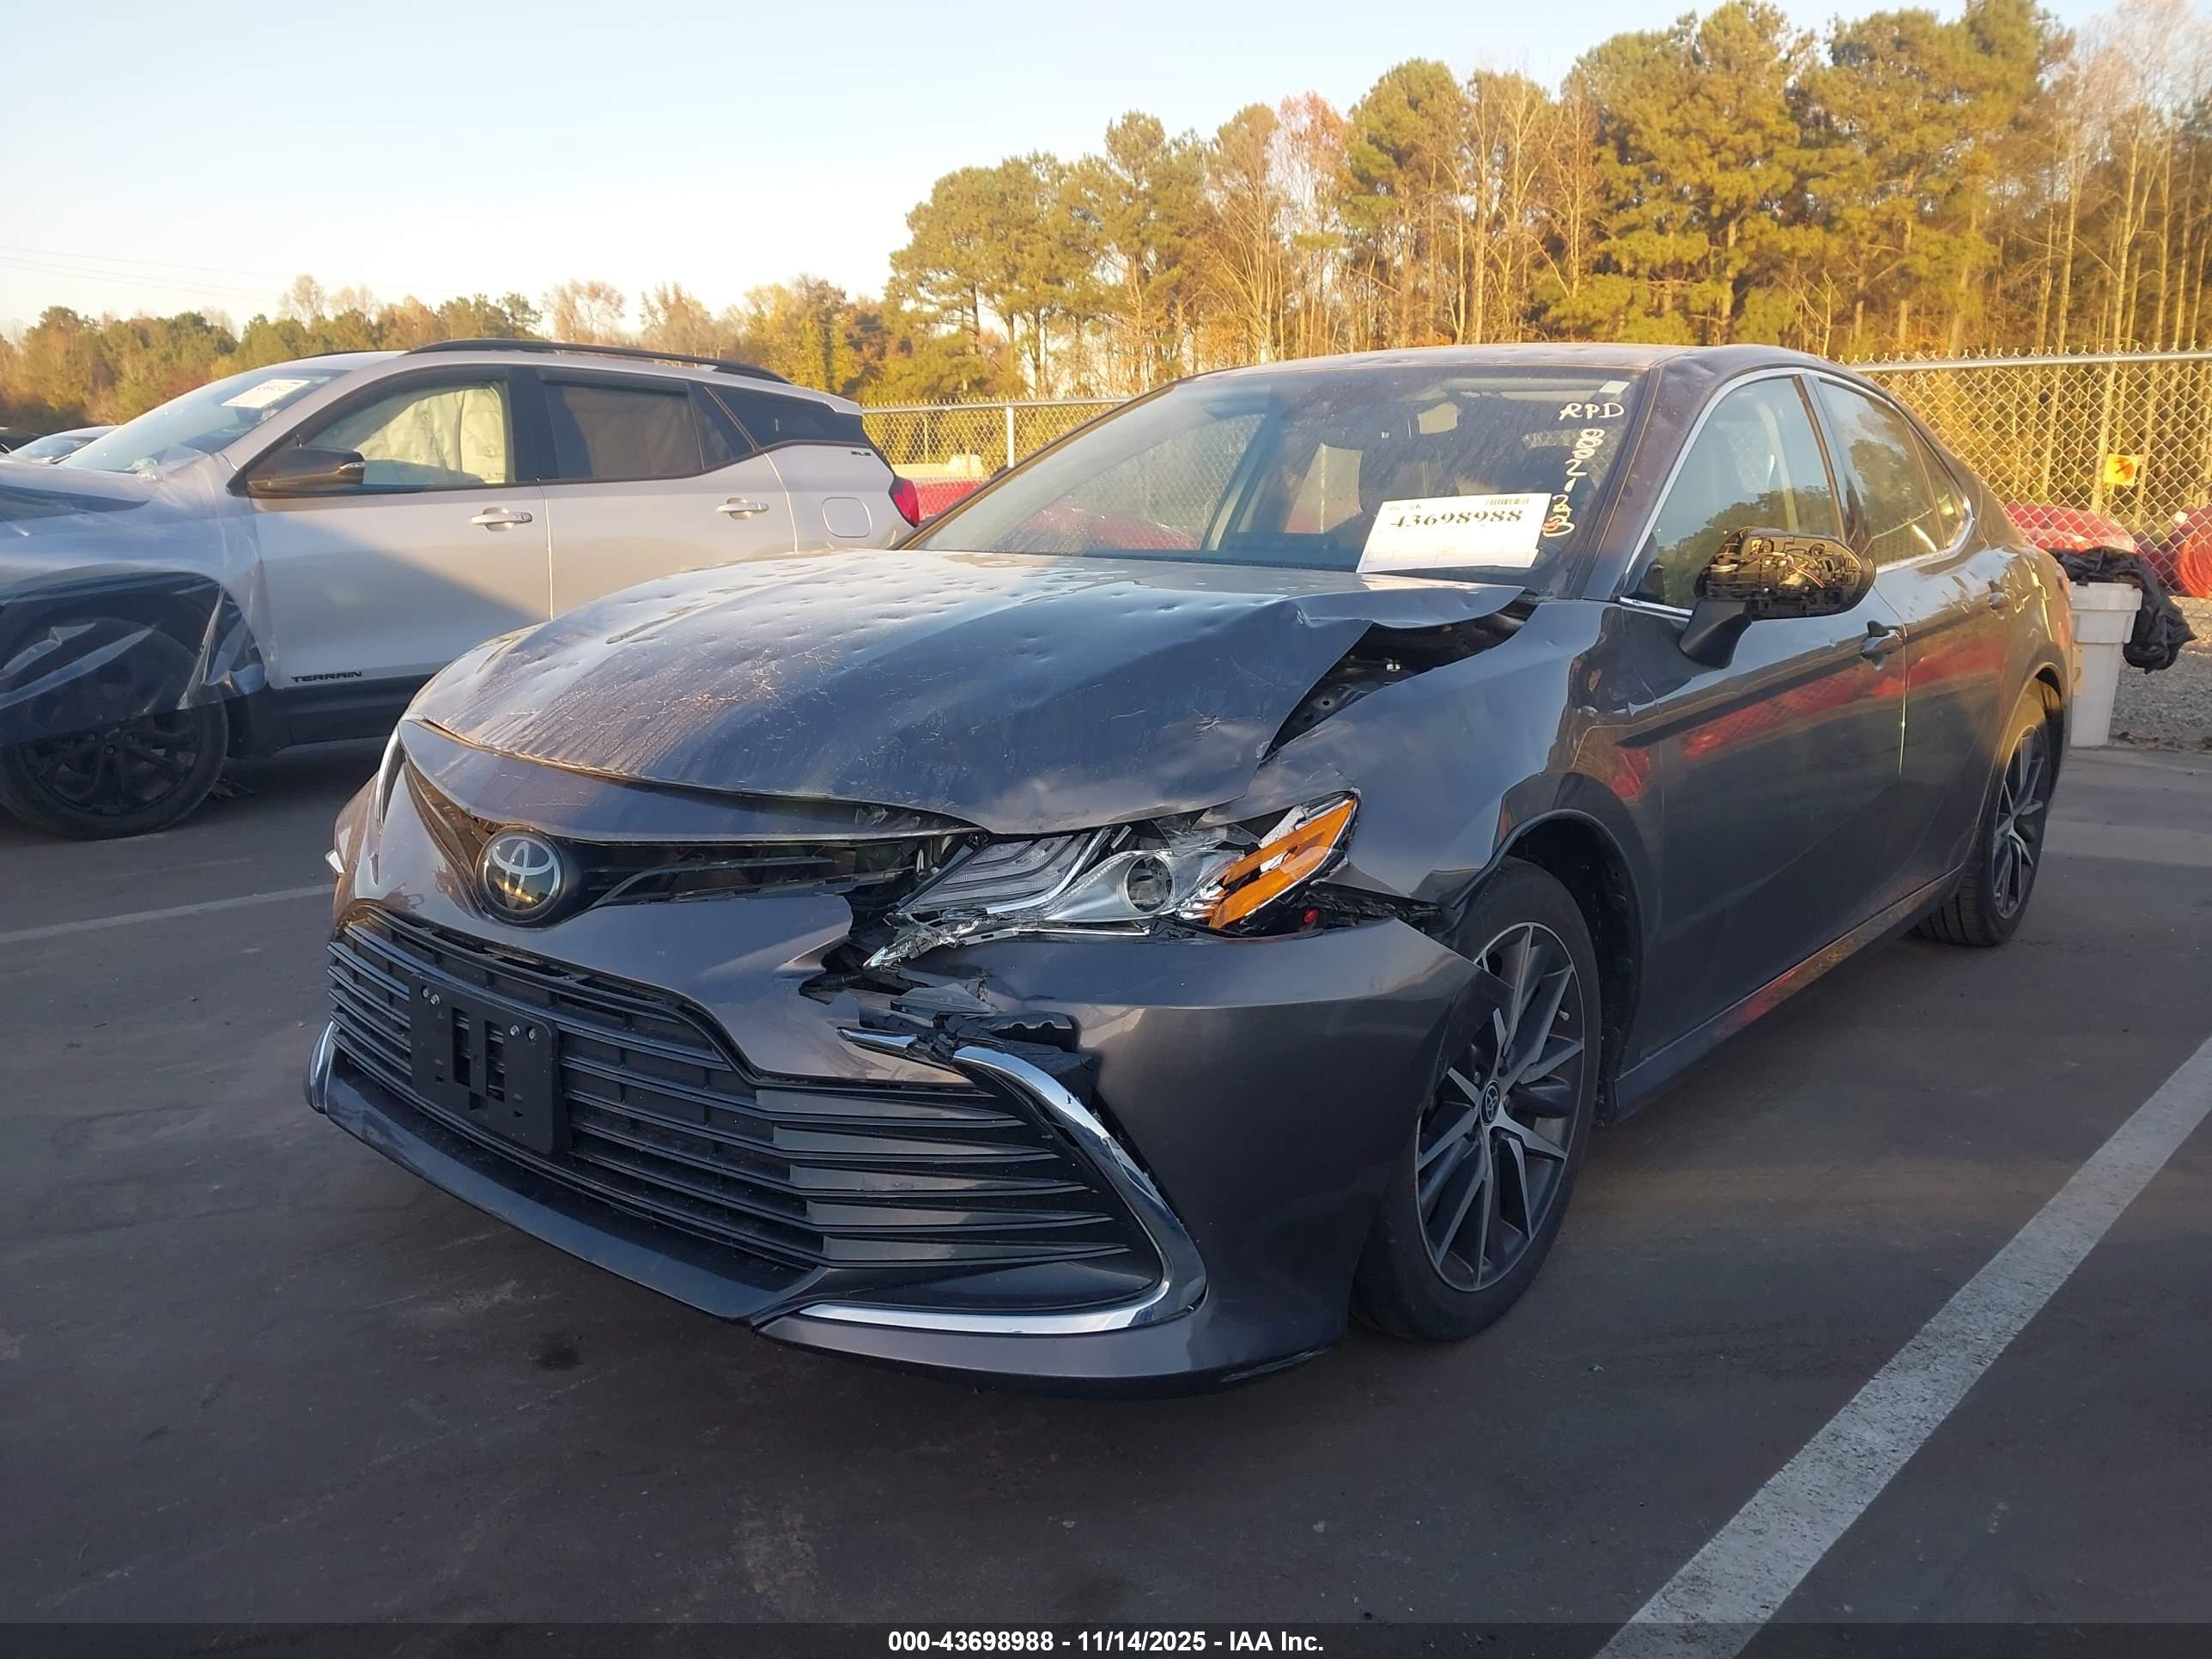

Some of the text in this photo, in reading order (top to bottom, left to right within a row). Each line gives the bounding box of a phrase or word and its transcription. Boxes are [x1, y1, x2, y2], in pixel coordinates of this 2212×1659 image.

[1559, 402, 1625, 421] RPD
[1390, 509, 1523, 527] 43698988
[291, 671, 362, 683] TERRAIN
